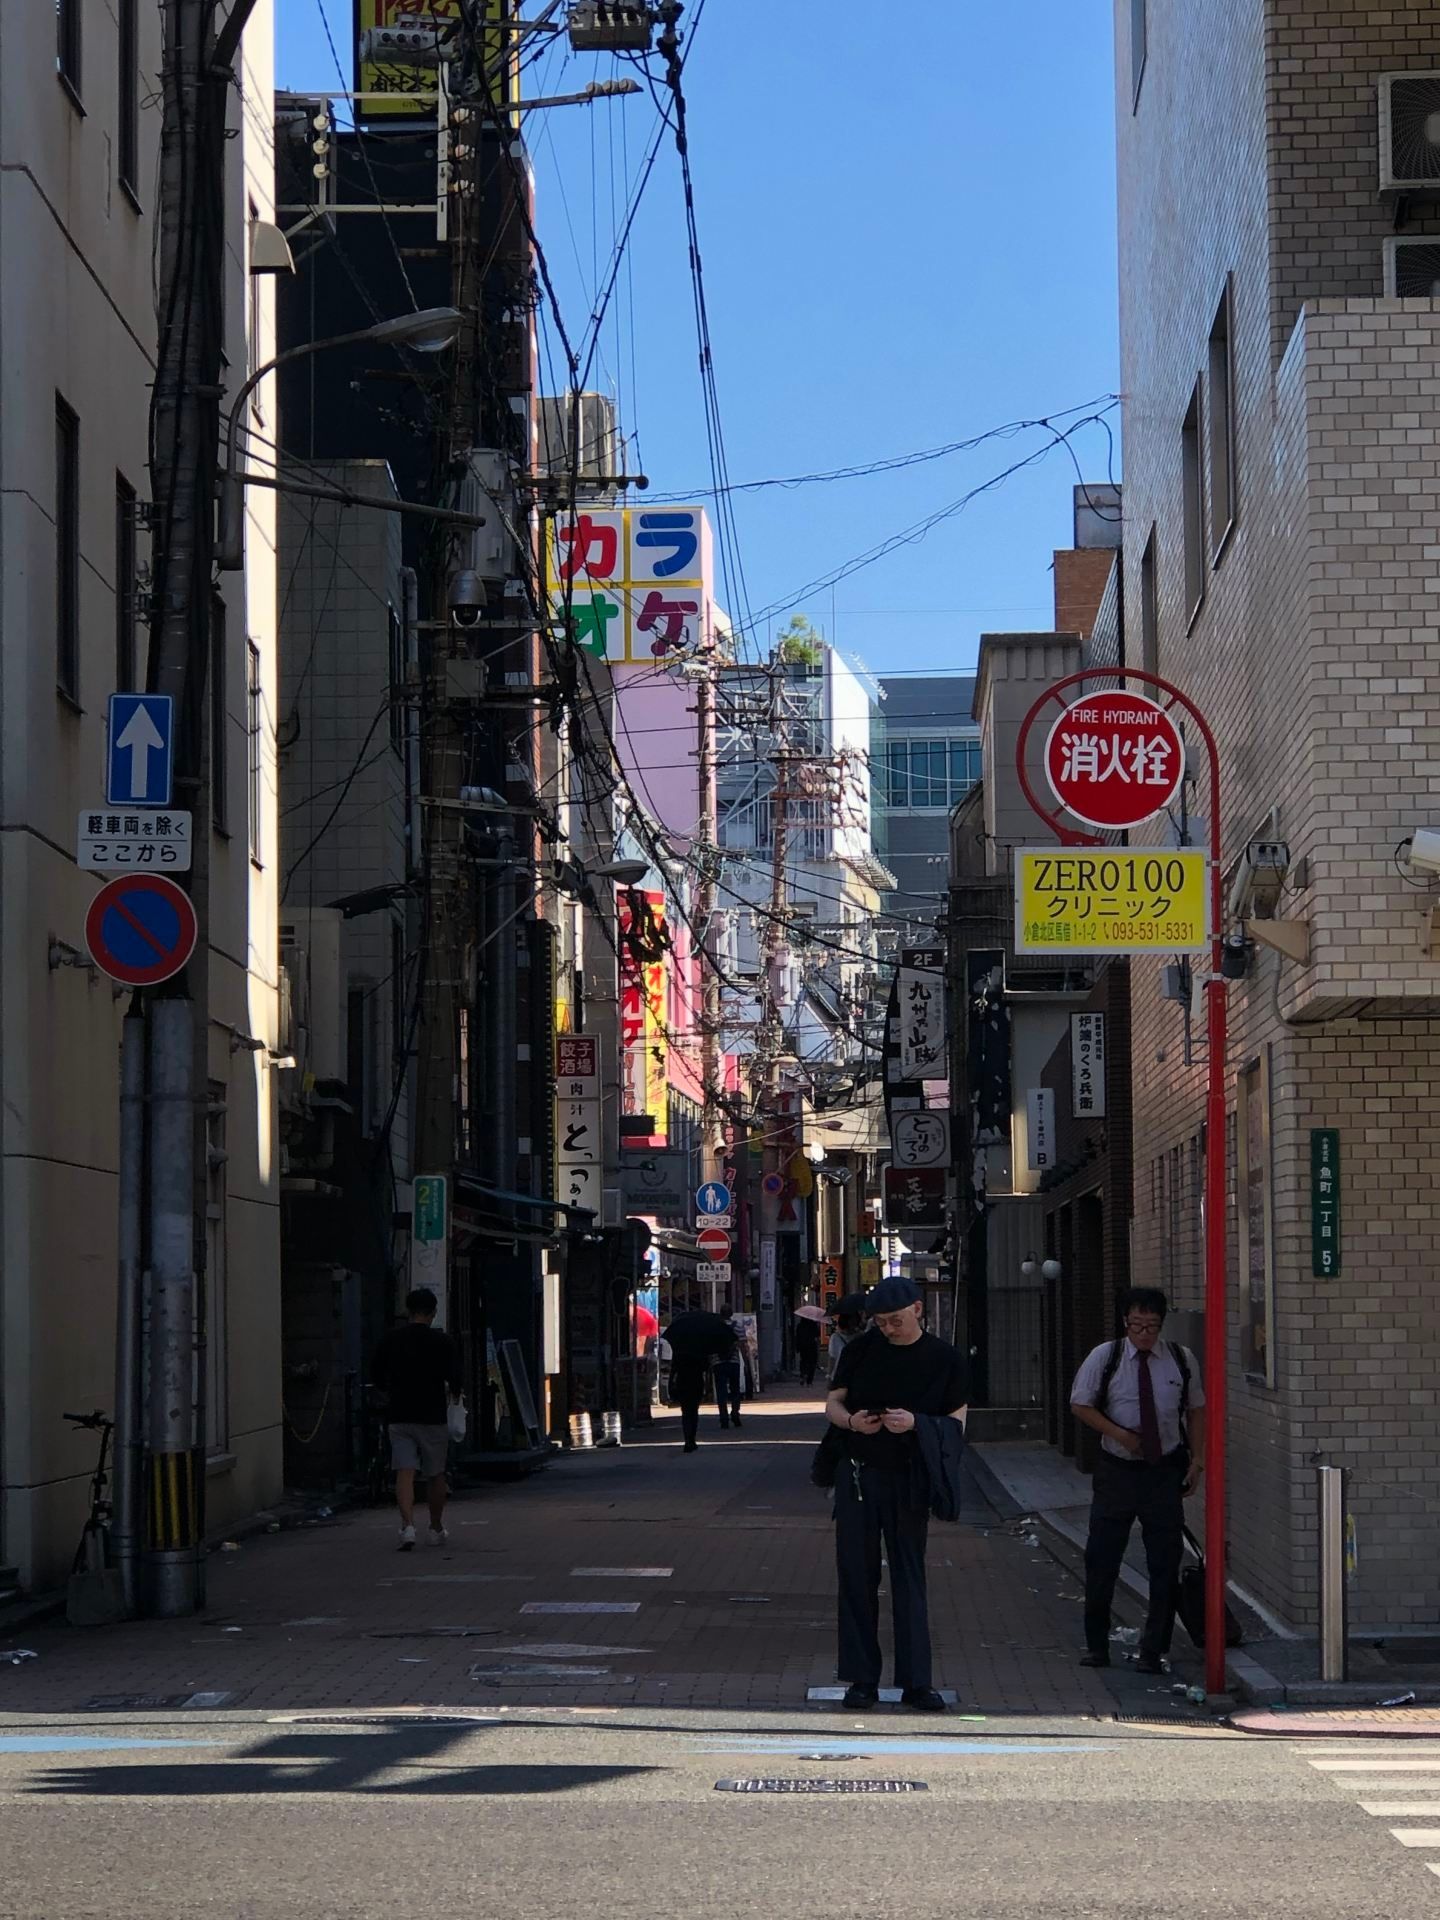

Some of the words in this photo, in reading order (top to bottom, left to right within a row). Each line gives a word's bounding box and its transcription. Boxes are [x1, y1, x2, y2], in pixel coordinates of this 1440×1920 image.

[558, 513, 698, 579] カラ
[558, 591, 698, 657] オケ
[1072, 709, 1099, 724] FIRE
[1103, 709, 1160, 725] HYDRANT
[1060, 732, 1172, 785] 消火栓
[87, 815, 185, 836] 軽車両を除く
[92, 843, 178, 863] ここから
[1034, 859, 1185, 893] ZERO100
[1047, 895, 1172, 919] クリニック
[1112, 922, 1194, 941] 093-531-5331
[913, 953, 933, 966] 2F
[560, 1042, 593, 1058] 餃子
[560, 1058, 593, 1075] 酒場
[1079, 1015, 1093, 1110] 炉端のくろ兵衛
[913, 1117, 931, 1152] とりの
[1037, 1152, 1047, 1165] B
[1320, 1166, 1332, 1237] 魚町一丁目
[698, 1217, 729, 1226] 10-22
